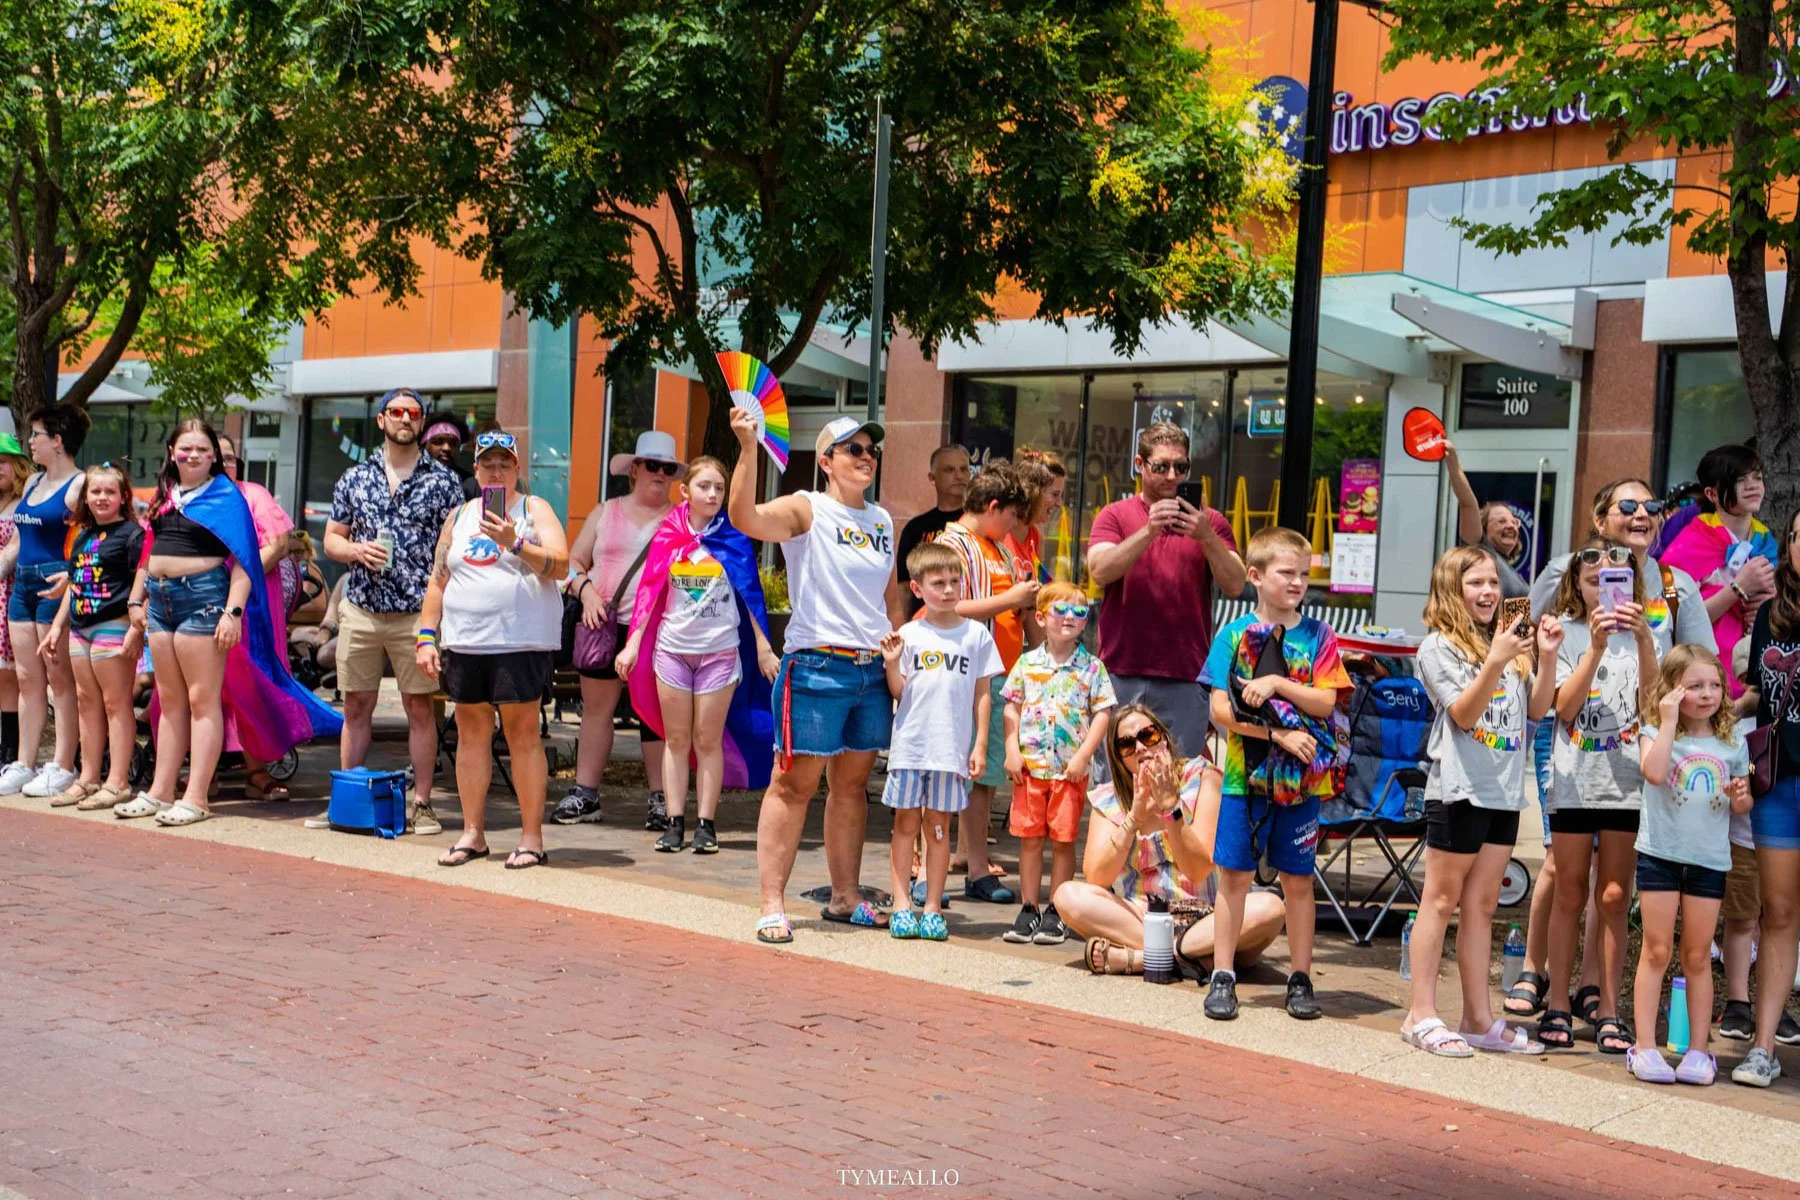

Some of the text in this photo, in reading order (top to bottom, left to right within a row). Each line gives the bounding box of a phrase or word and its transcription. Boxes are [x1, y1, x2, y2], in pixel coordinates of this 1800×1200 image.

[1496, 376, 1538, 394] Suite
[1503, 398, 1529, 416] 100
[1048, 417, 1131, 454] WRM
[836, 527, 892, 556] LOVE
[913, 650, 970, 676] LOVE
